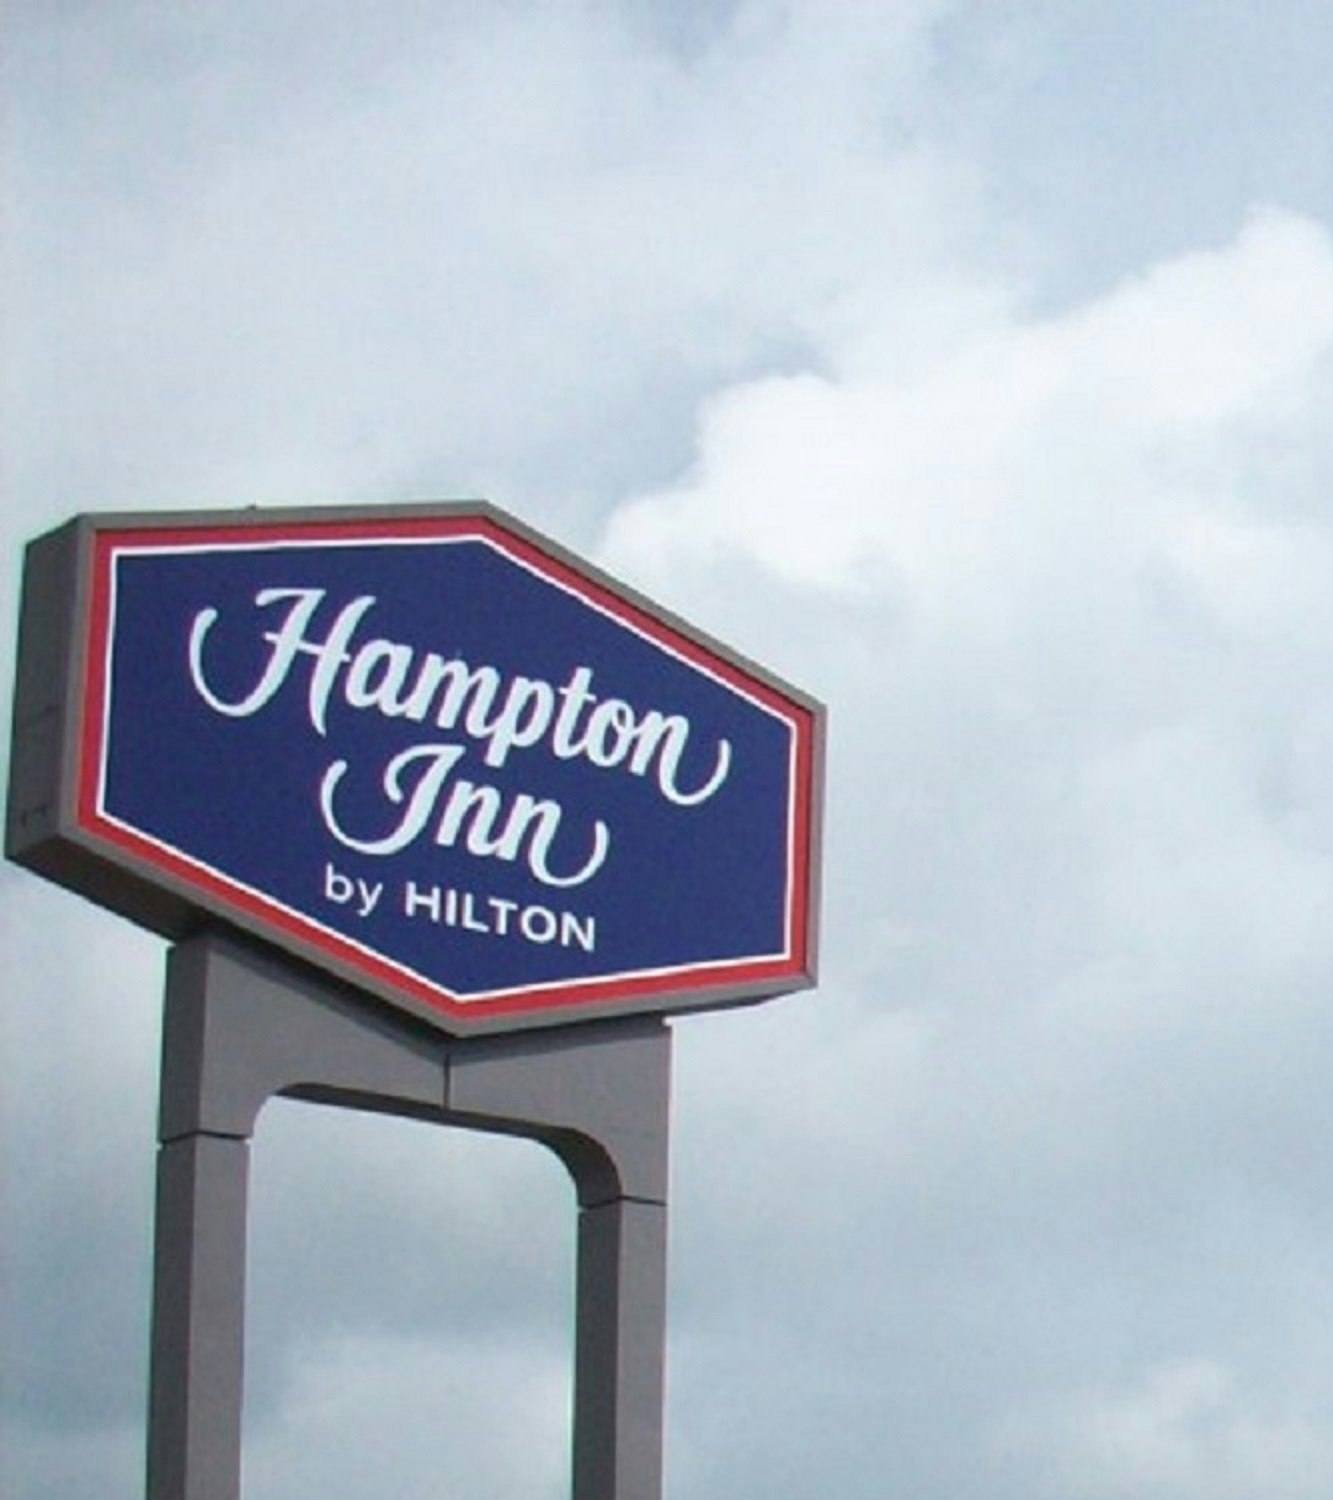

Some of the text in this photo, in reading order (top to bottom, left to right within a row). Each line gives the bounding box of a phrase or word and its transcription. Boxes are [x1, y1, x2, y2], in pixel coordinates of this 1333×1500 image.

[189, 587, 732, 806] Hampton
[319, 743, 610, 888] Inn
[324, 864, 597, 952] by HILTON
